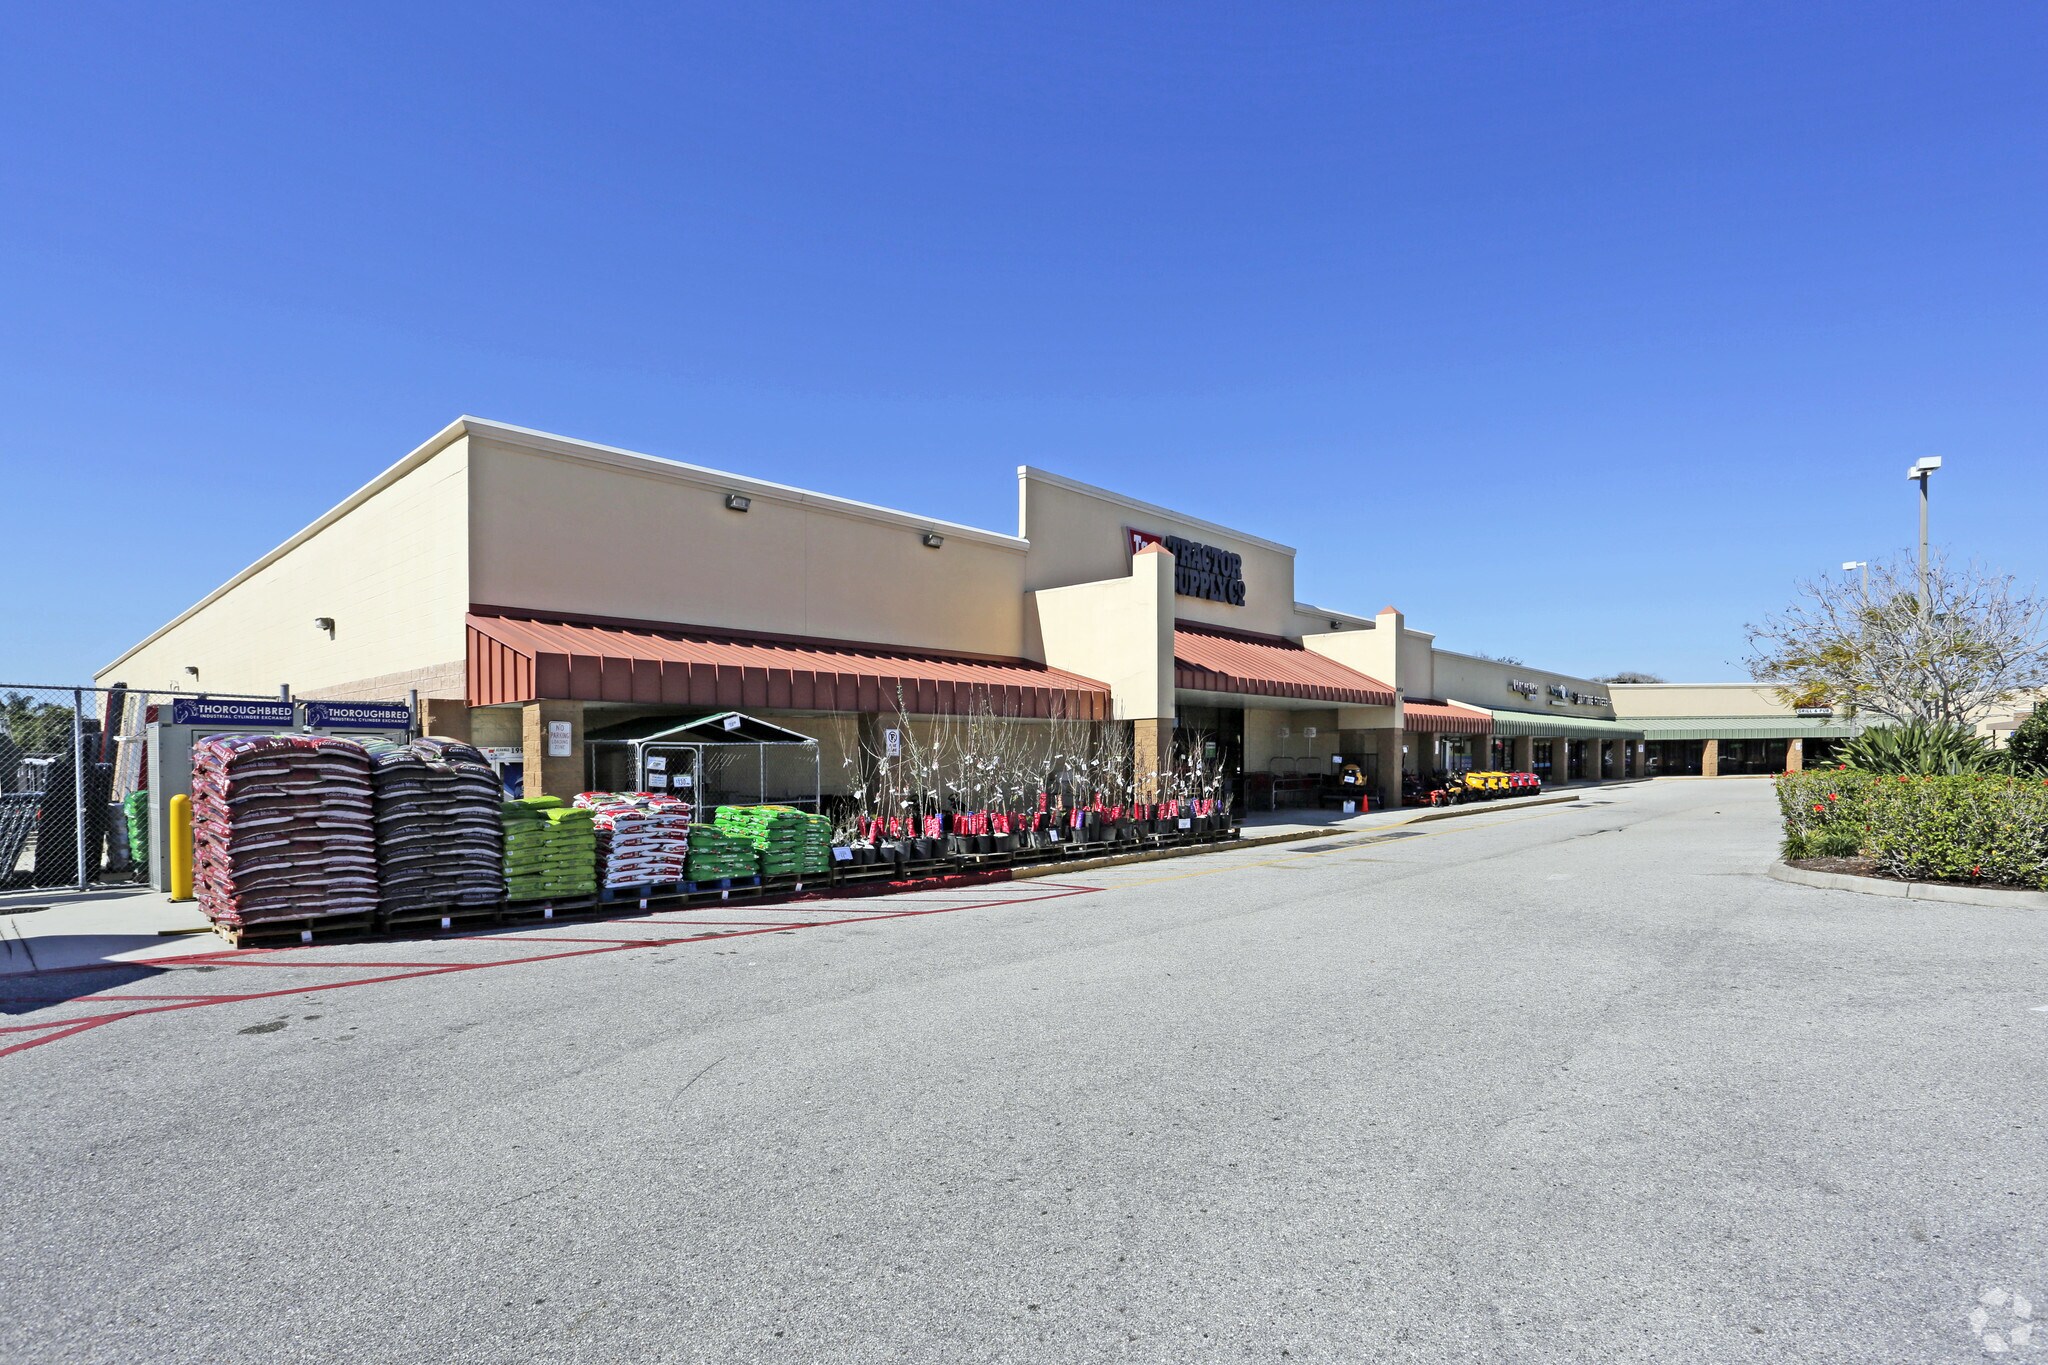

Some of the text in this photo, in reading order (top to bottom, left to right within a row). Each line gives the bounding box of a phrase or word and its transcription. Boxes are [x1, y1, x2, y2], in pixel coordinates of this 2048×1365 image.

[1167, 535, 1242, 579] TRACTOR
[1175, 566, 1227, 602] UPPLY
[198, 704, 293, 716] THOROUGHBRED
[328, 708, 409, 719] THOROUGHBRED
[555, 724, 565, 732] NO
